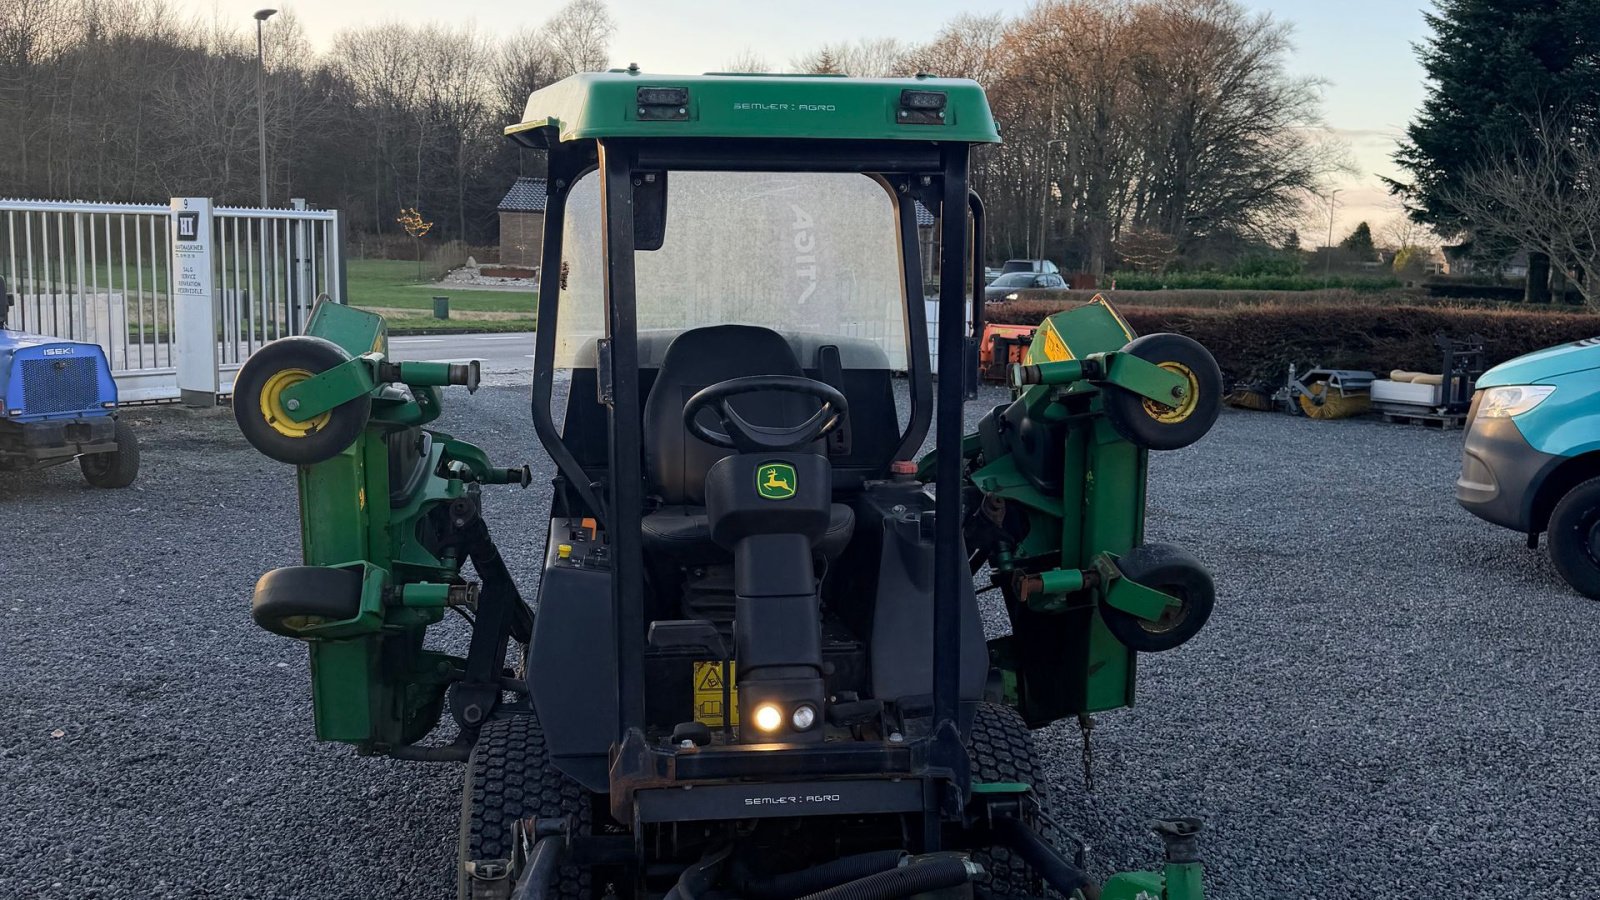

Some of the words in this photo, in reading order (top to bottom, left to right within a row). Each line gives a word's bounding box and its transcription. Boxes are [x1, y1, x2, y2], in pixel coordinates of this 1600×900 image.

[184, 199, 188, 209] 9
[43, 347, 74, 356] ISEKI
[744, 796, 796, 805] SEMLER
[806, 794, 840, 802] AGRO
